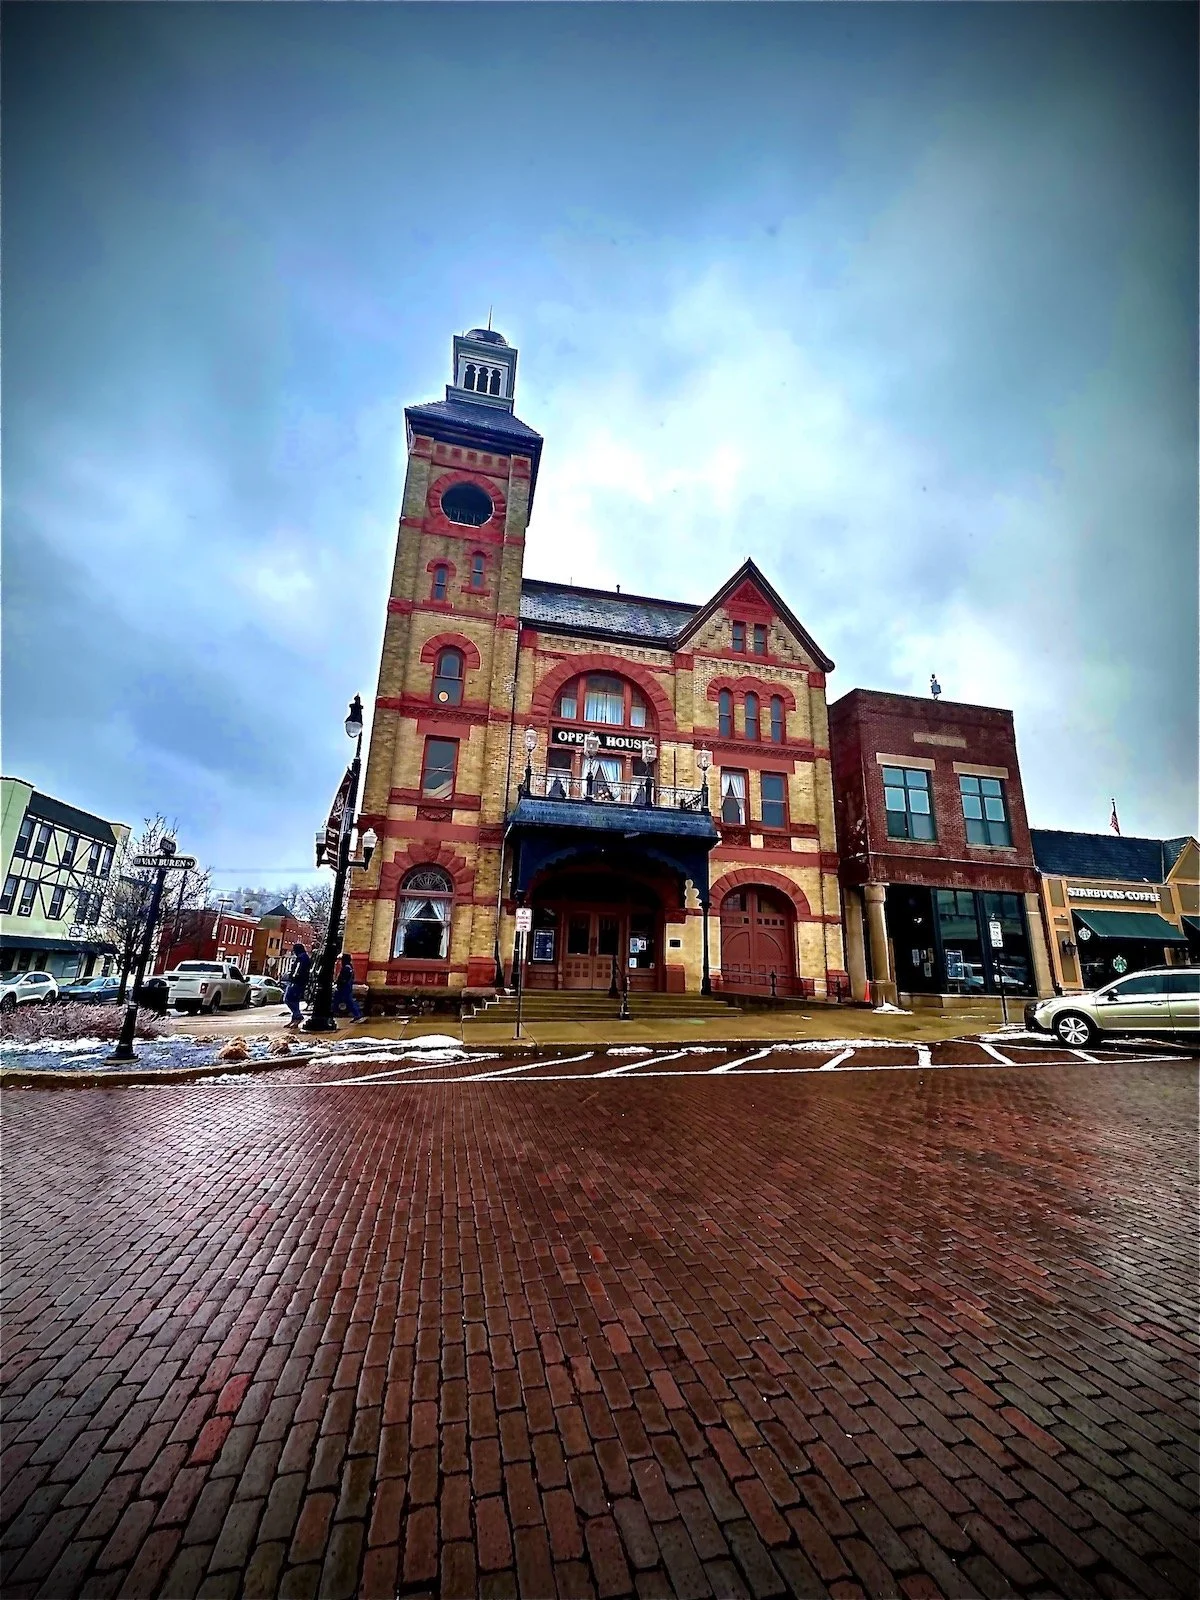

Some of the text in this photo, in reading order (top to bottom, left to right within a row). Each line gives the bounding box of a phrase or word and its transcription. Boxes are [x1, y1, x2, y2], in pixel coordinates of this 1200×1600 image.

[141, 858, 158, 866] VAN
[158, 858, 187, 867] BUREN
[1067, 887, 1161, 901] STARBUCKS COFFEE
